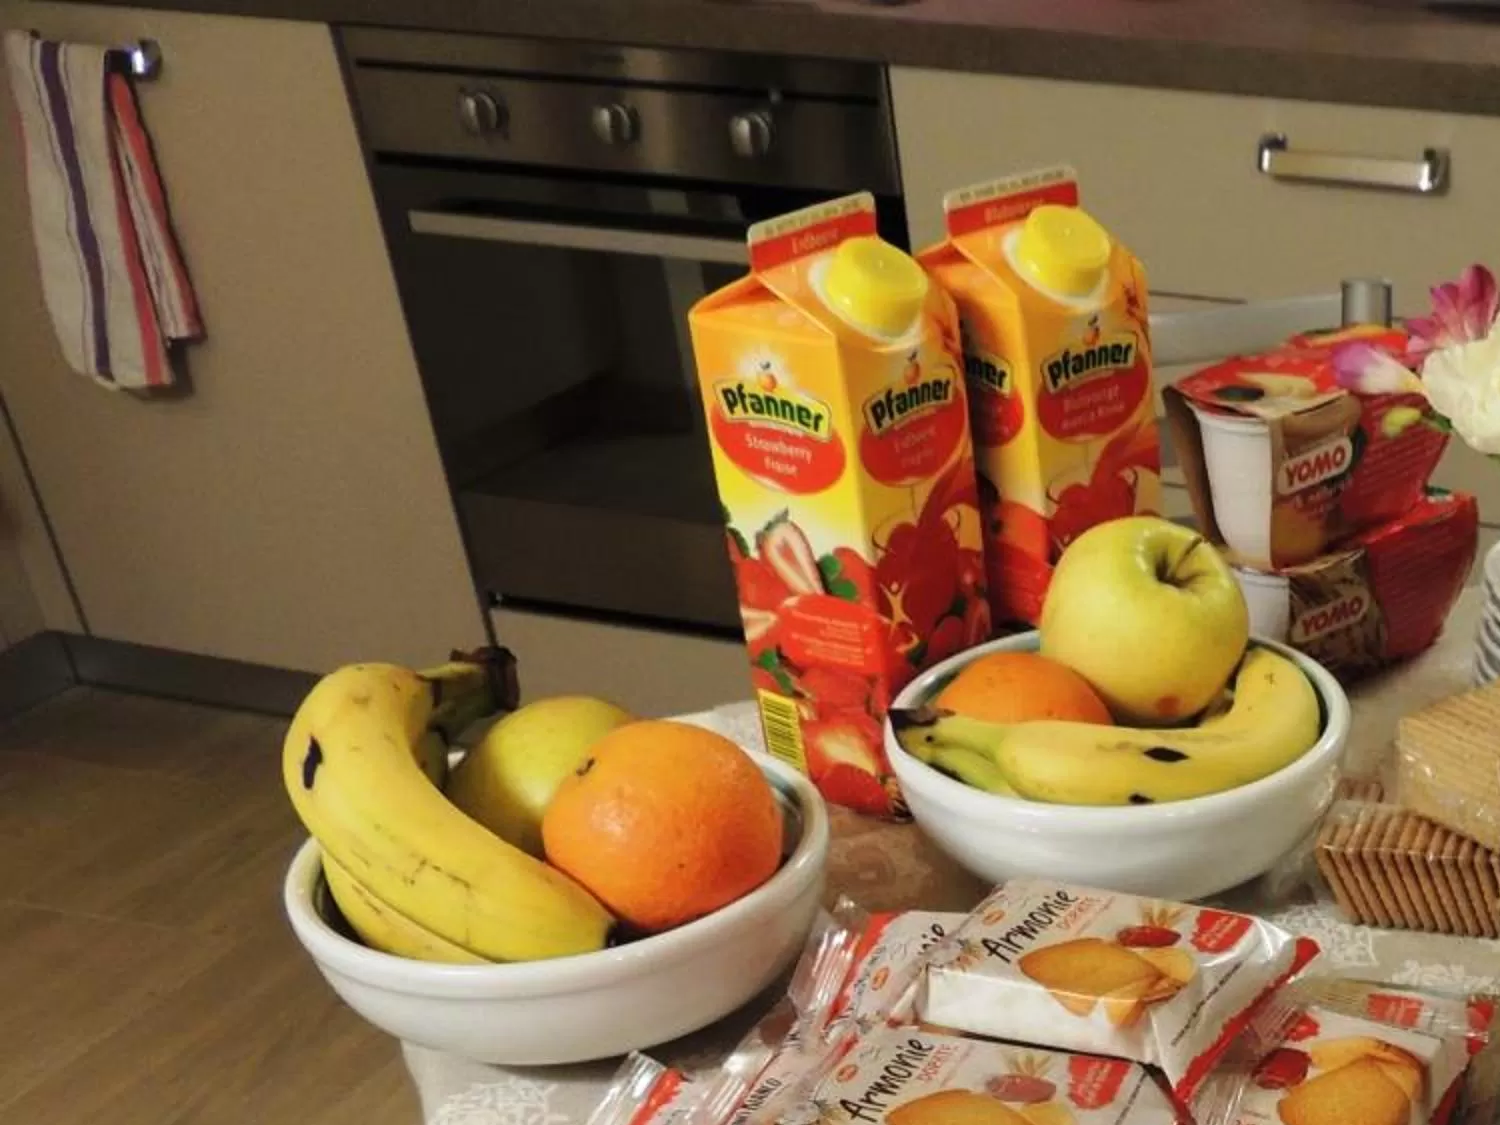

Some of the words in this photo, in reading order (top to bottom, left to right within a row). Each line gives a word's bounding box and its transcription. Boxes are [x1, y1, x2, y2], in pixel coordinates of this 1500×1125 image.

[1048, 342, 1133, 389] Pfanner
[722, 383, 824, 432] Pfanner
[871, 379, 952, 429] Pfanner
[744, 432, 813, 465] Strawberry
[1286, 446, 1346, 487] YOMO
[1301, 597, 1363, 637] YOMO
[980, 888, 1078, 965] Armonie
[839, 1038, 935, 1124] Armonie
